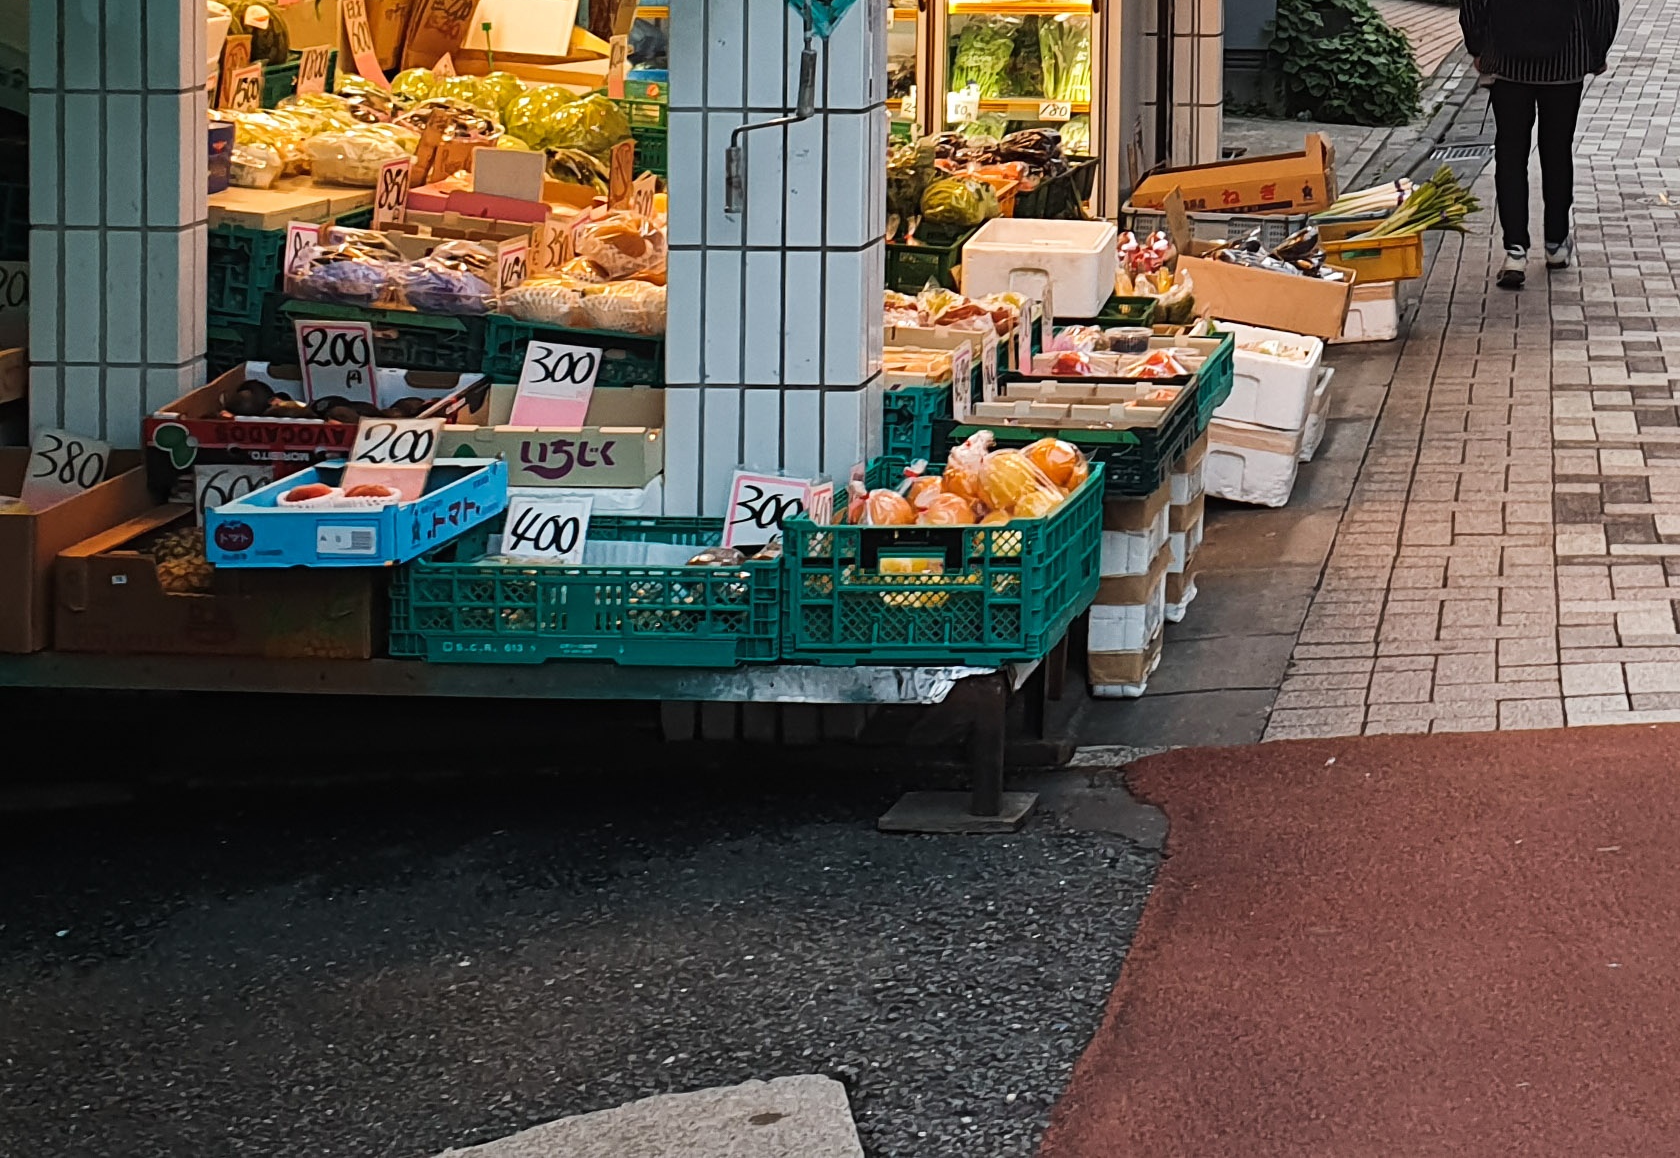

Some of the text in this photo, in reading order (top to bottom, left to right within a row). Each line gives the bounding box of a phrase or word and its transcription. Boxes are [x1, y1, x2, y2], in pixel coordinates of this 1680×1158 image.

[303, 327, 371, 368] 200
[528, 345, 596, 385] 300
[31, 433, 104, 490] 380
[356, 422, 434, 464] 200
[729, 485, 804, 531] 300
[509, 506, 580, 555] 400
